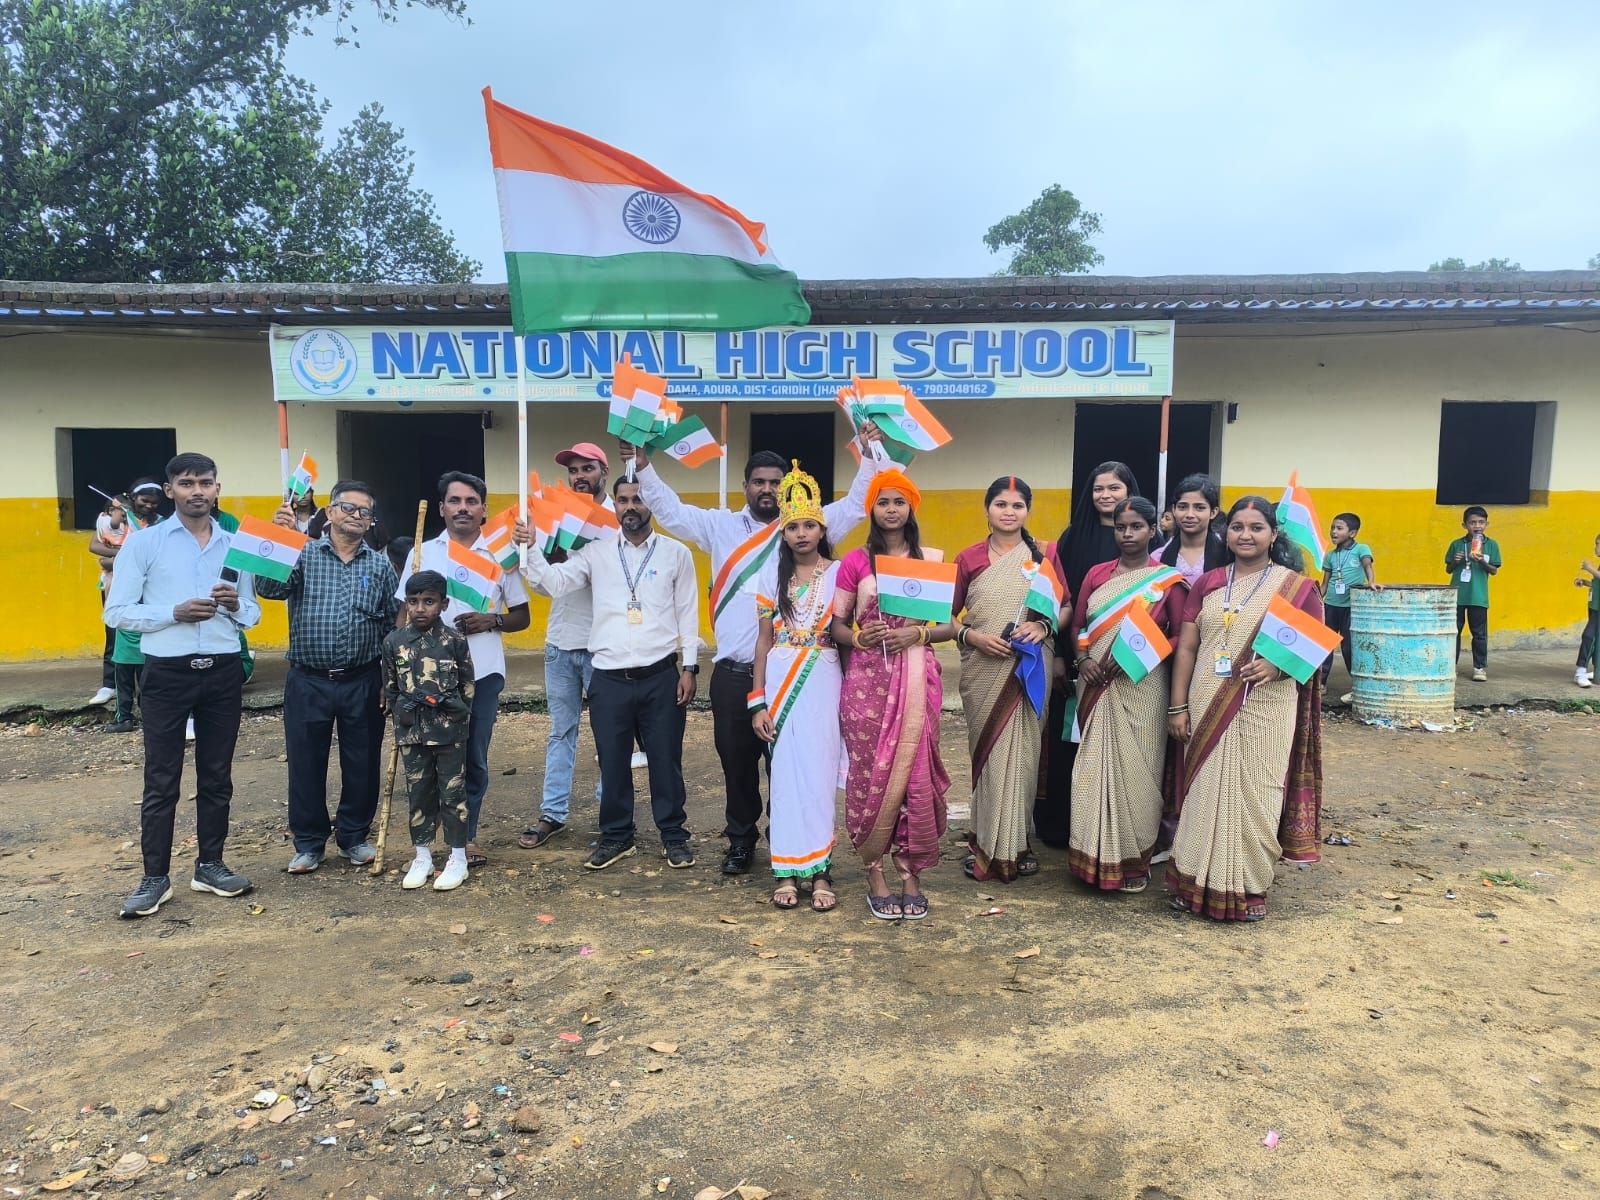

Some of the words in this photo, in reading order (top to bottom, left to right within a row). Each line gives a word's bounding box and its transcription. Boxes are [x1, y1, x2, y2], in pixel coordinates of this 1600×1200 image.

[370, 330, 702, 379] NATIONAL
[715, 330, 878, 379] HIGH
[892, 327, 1153, 379] SCHOOL
[923, 383, 988, 395] 7903048162
